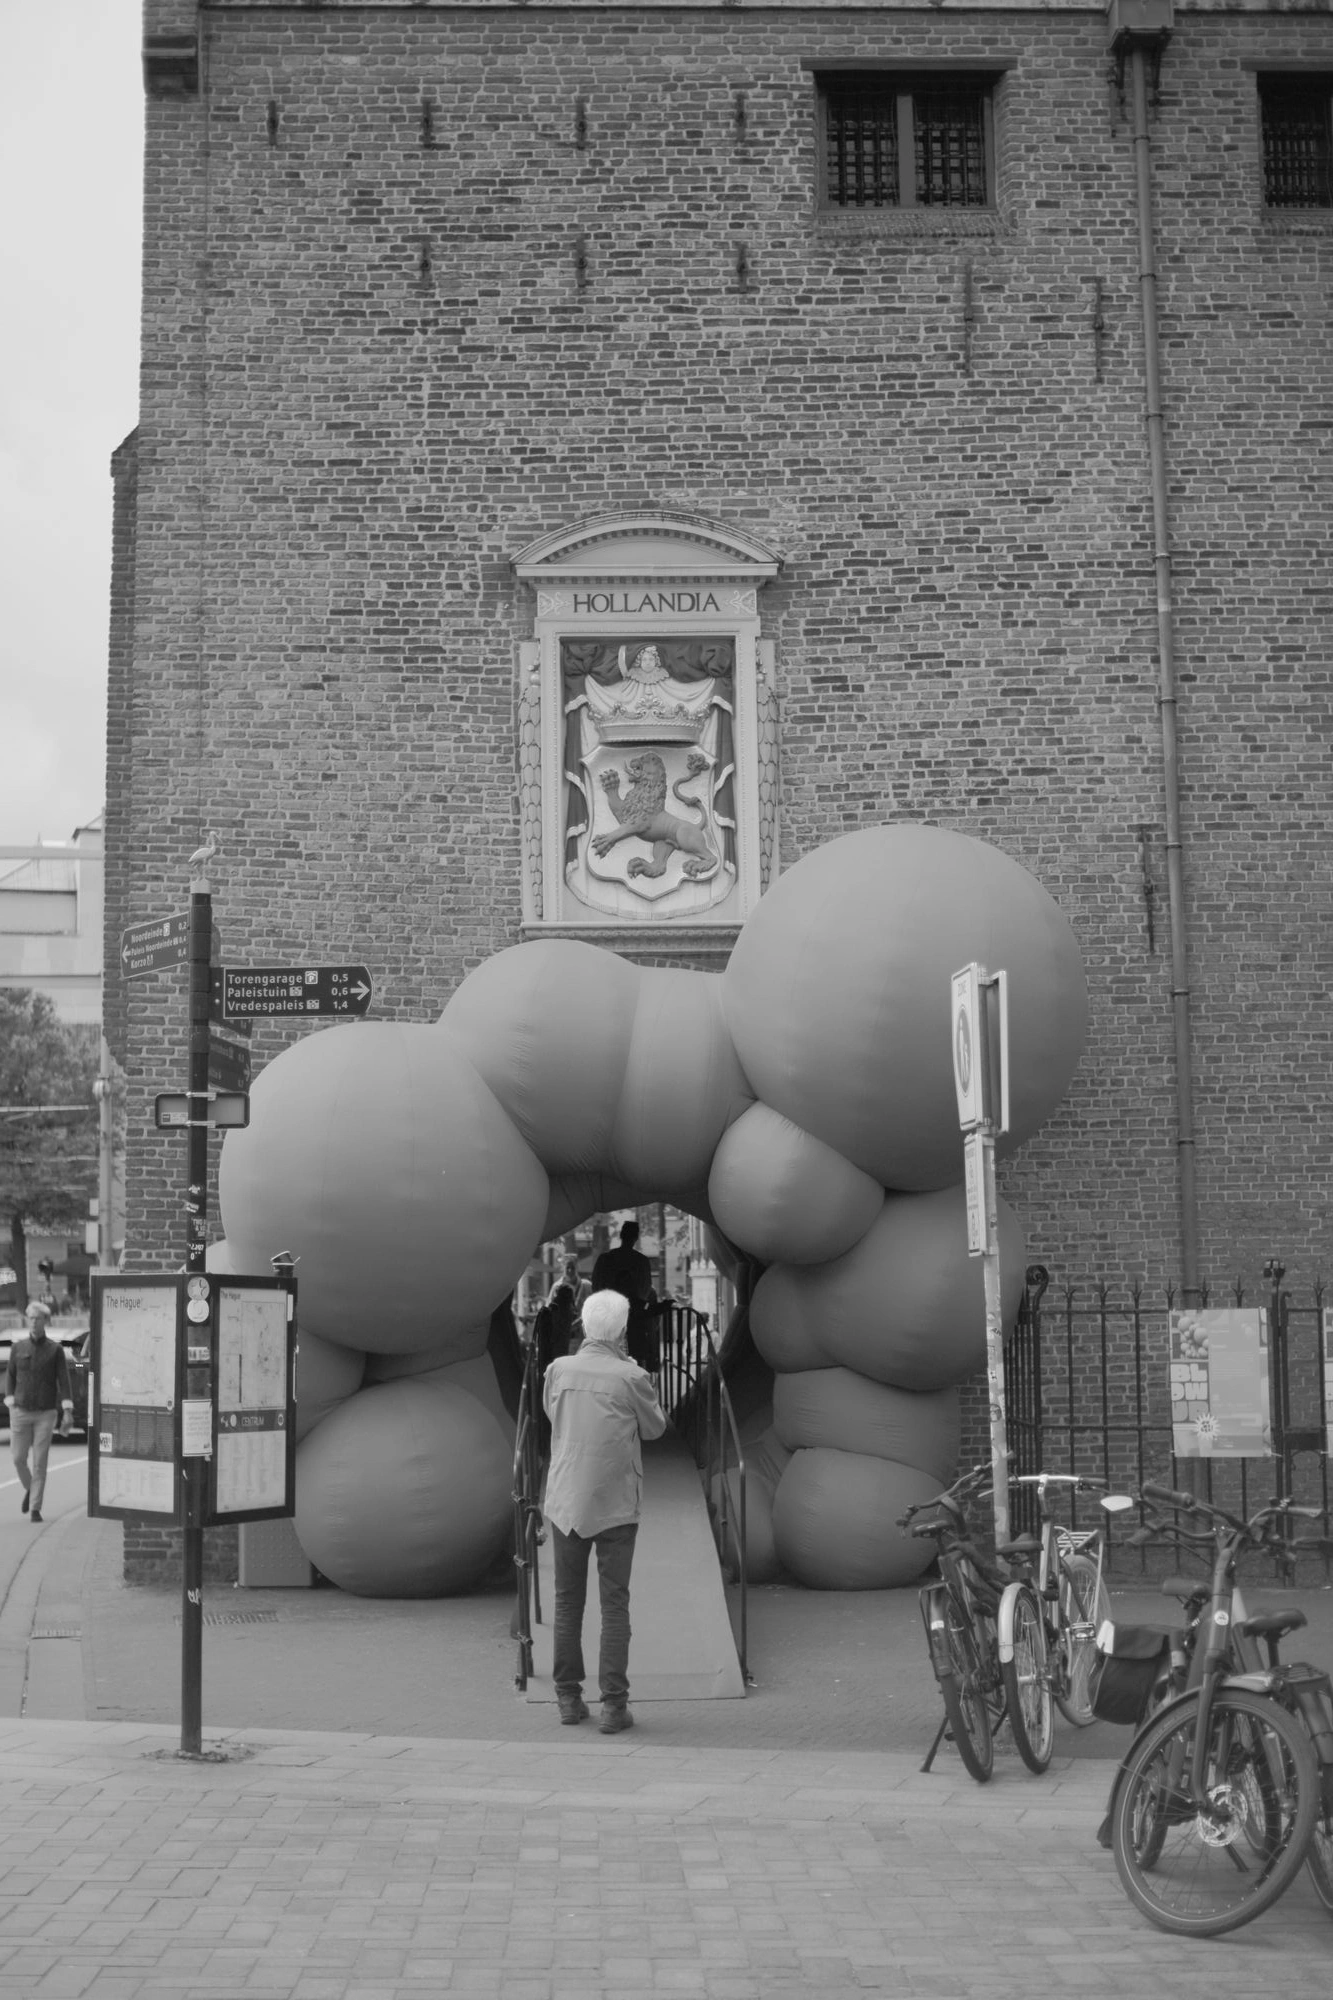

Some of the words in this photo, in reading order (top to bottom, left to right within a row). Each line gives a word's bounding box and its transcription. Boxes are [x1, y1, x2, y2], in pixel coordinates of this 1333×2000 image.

[573, 592, 721, 613] HOLLANDIA
[227, 974, 303, 986] Torengarage
[331, 974, 349, 984] 0,5
[227, 987, 287, 997] Paleistuin
[331, 987, 348, 997] 0,6
[227, 1001, 304, 1012] Vredespaleis
[333, 1001, 348, 1011] 1,4
[106, 1295, 119, 1308] The
[119, 1296, 141, 1311] Hague
